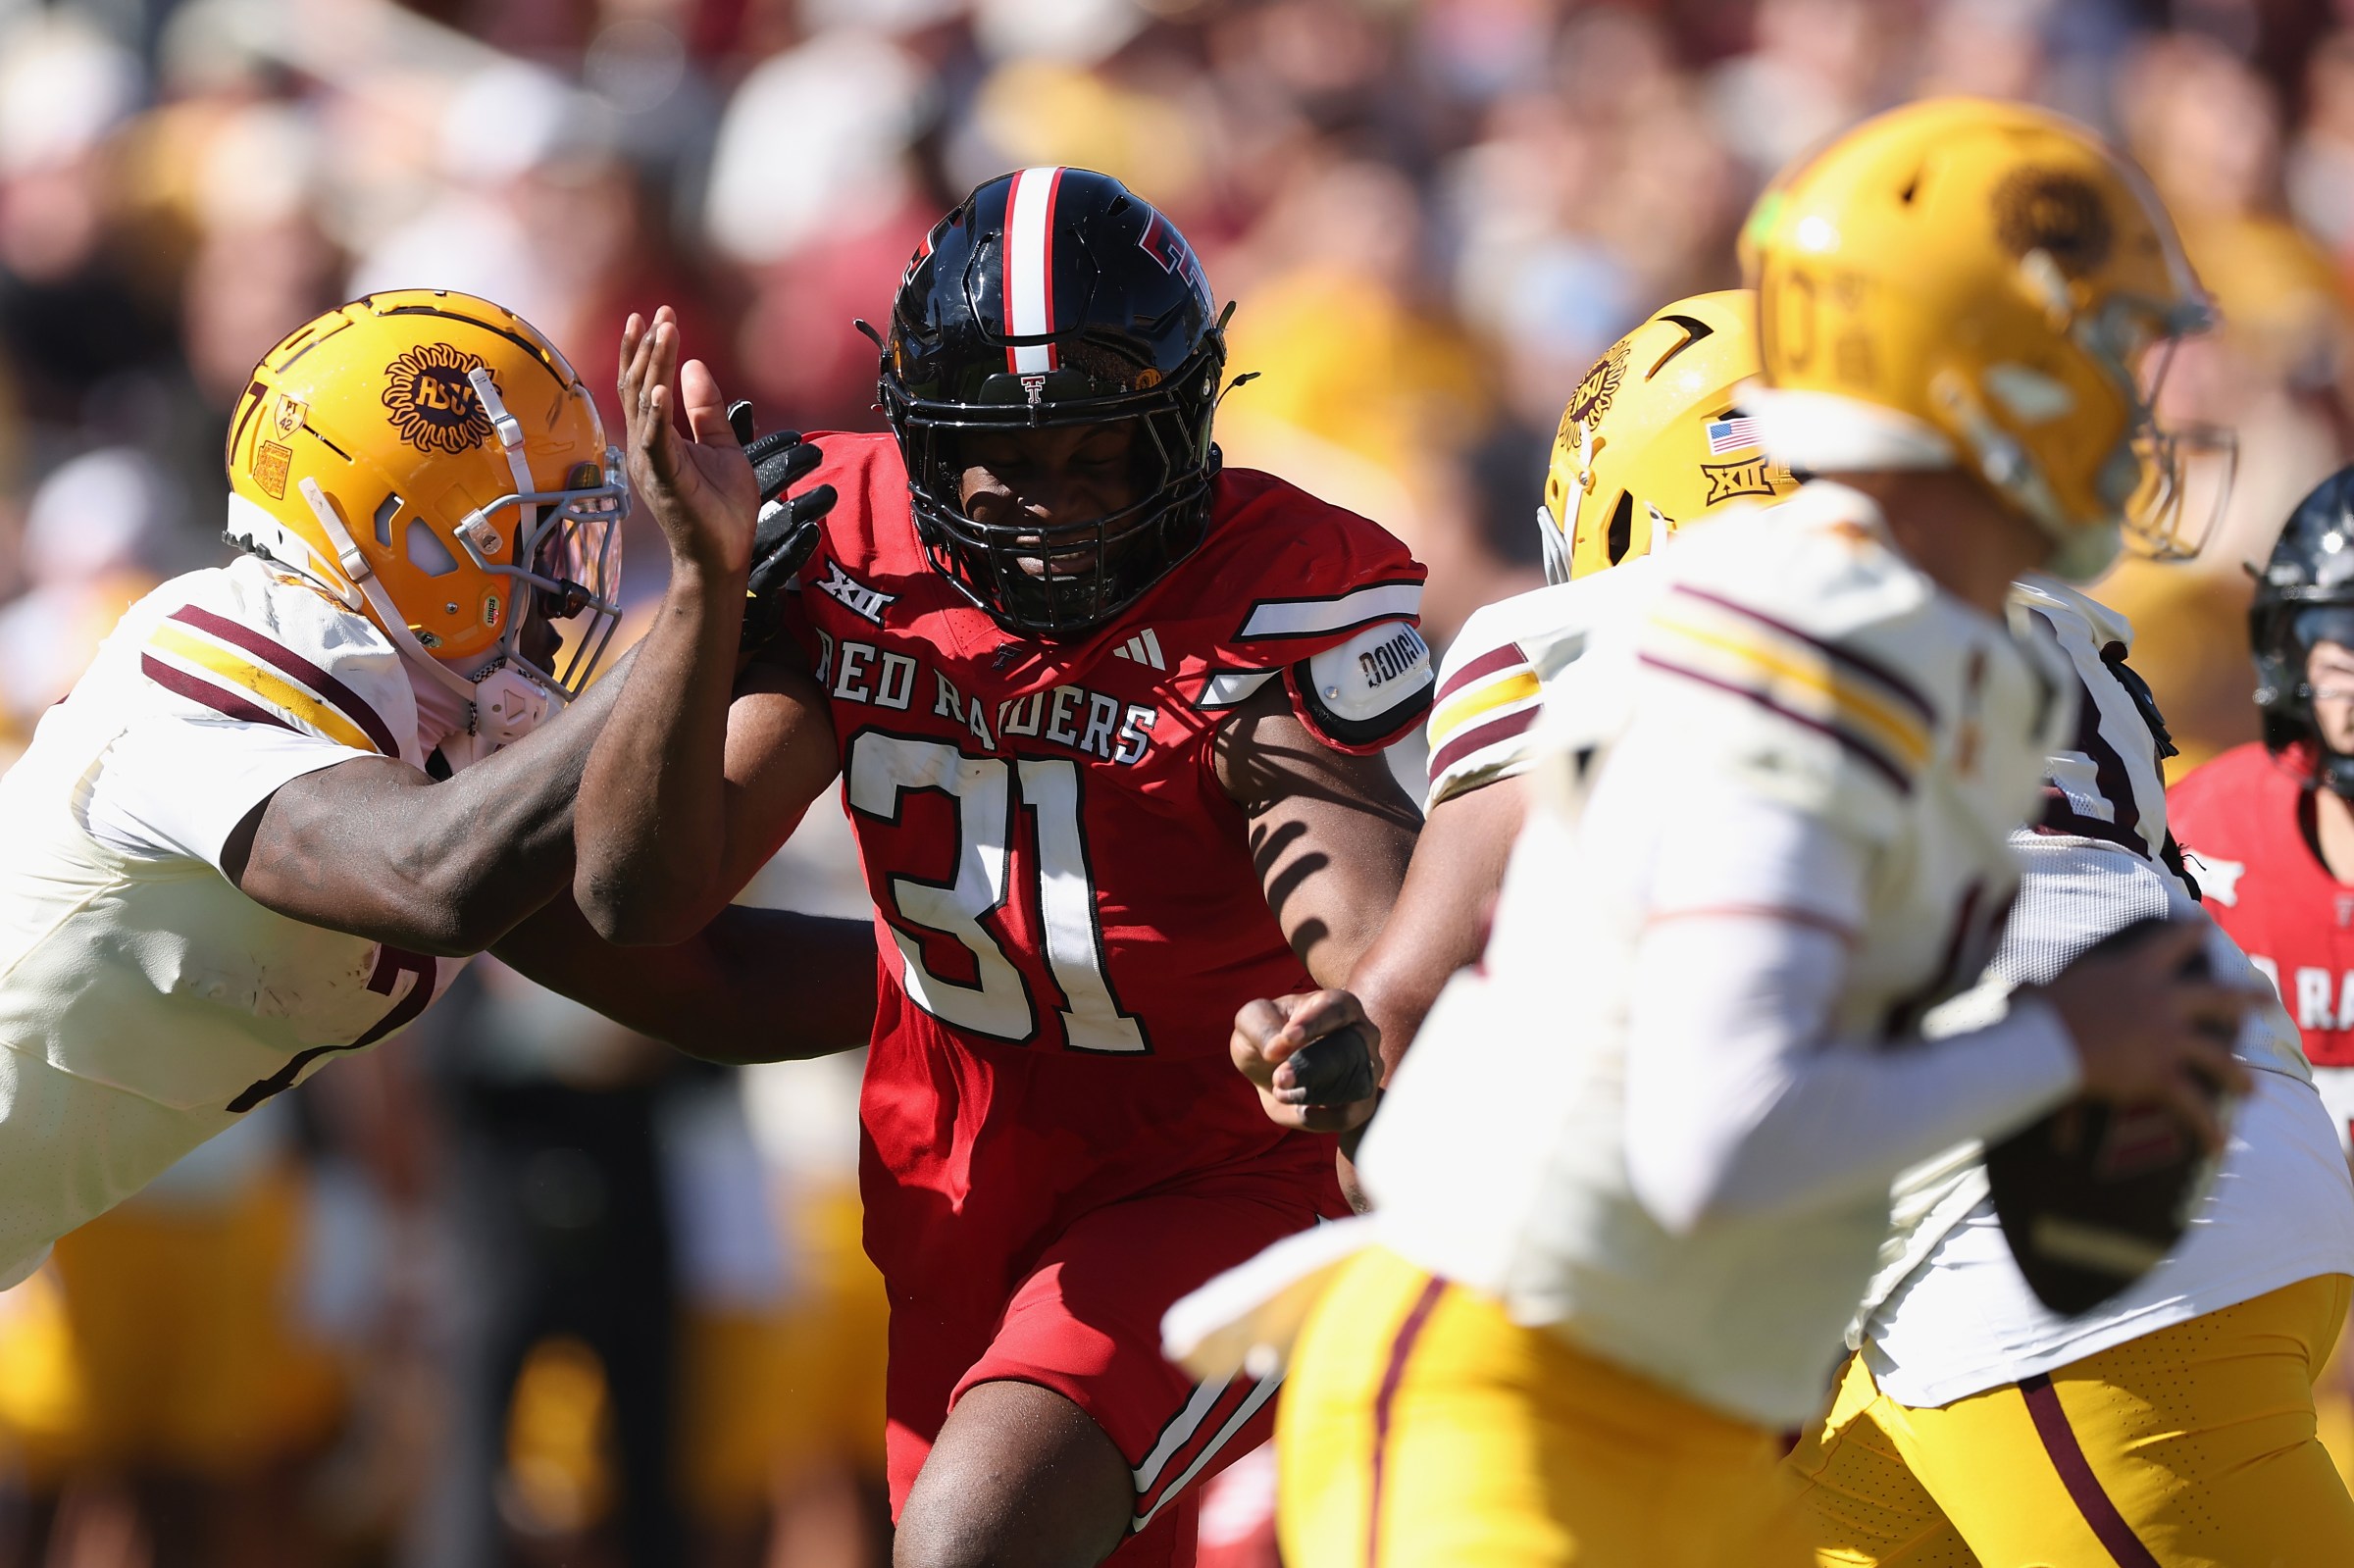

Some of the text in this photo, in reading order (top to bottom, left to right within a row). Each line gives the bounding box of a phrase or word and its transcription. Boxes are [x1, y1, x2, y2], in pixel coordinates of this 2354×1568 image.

[230, 380, 269, 467] 7
[279, 417, 293, 431] 42
[285, 400, 299, 415] PT
[415, 376, 474, 416] ASU
[815, 628, 1158, 765] RED RAIDERS
[847, 730, 1148, 1054] 31
